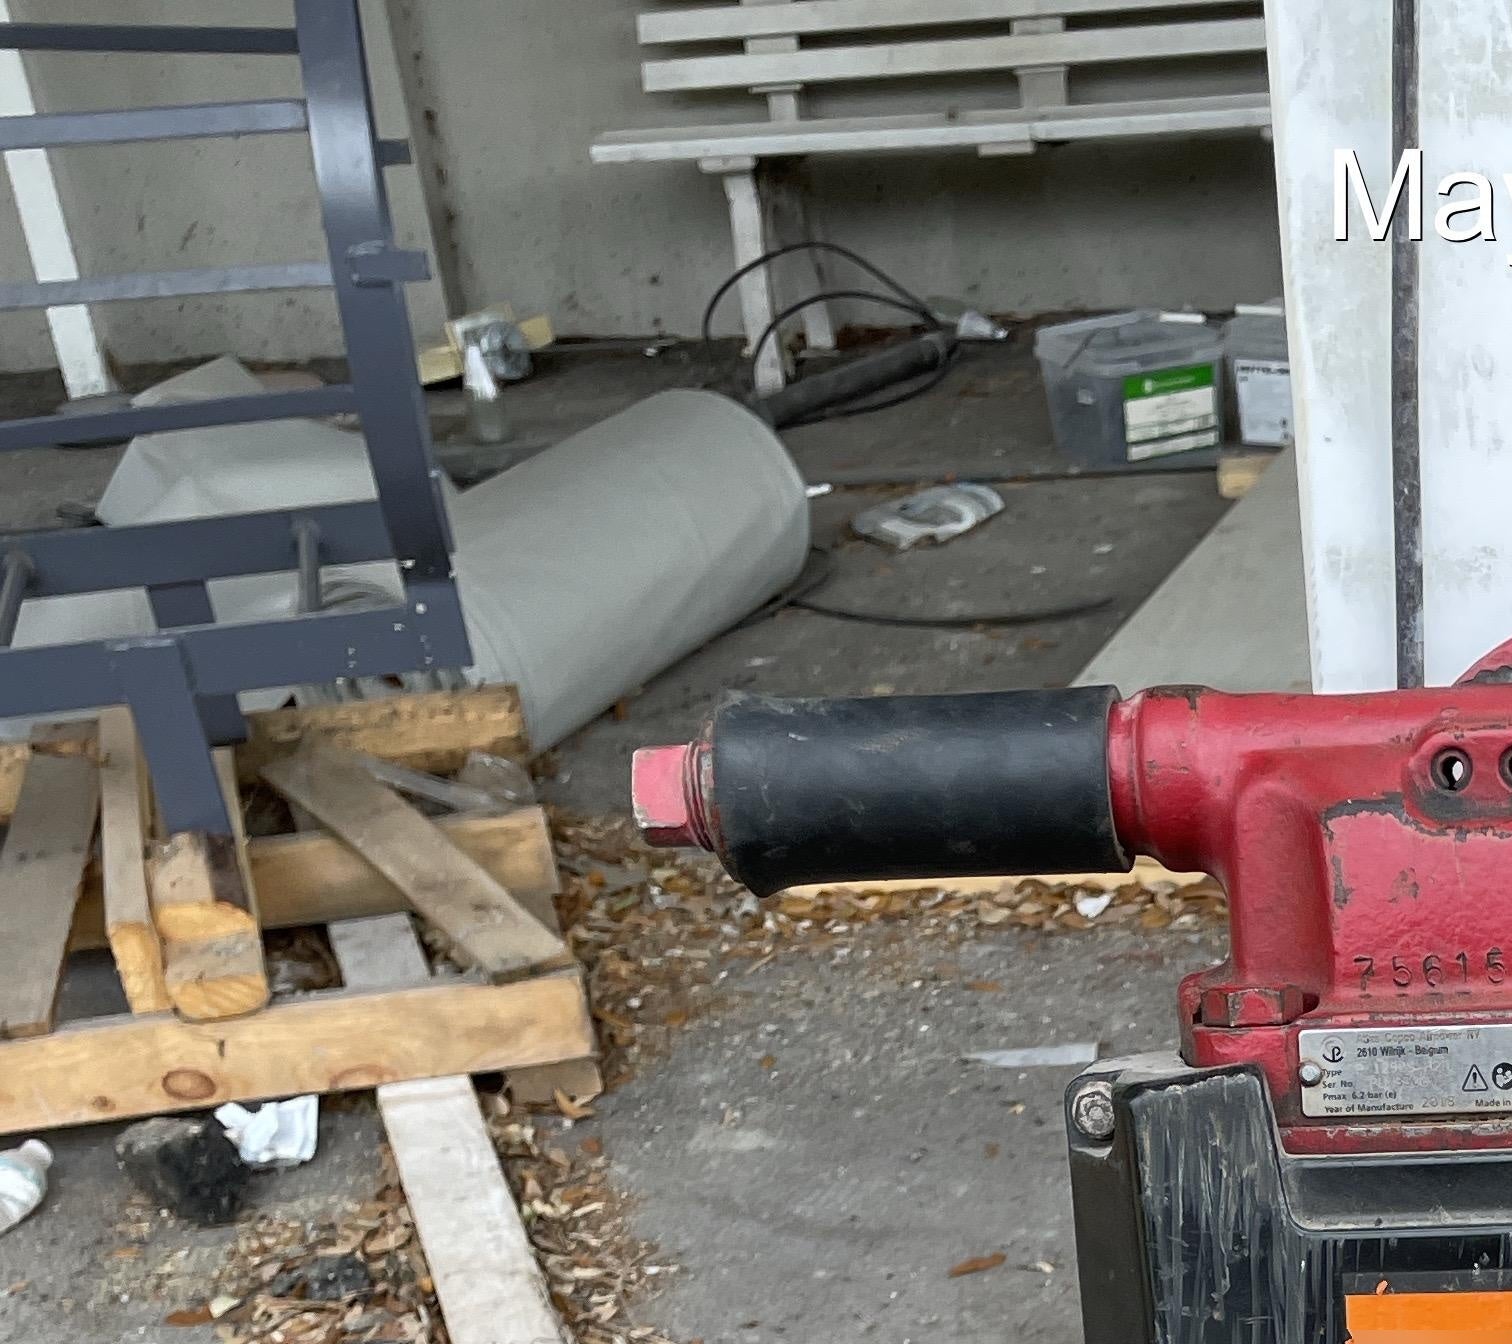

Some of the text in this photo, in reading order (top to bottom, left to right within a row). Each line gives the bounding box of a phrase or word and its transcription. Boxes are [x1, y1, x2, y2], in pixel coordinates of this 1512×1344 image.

[1357, 1047, 1378, 1058] 2610
[1321, 1068, 1343, 1078] Type
[1323, 1092, 1347, 1101] Pmax
[1367, 1091, 1382, 1100] bar
[1345, 1104, 1355, 1112] of
[1357, 1102, 1414, 1112] Manufacture
[1475, 1098, 1500, 1107] Made
[1503, 1098, 1512, 1107] in
